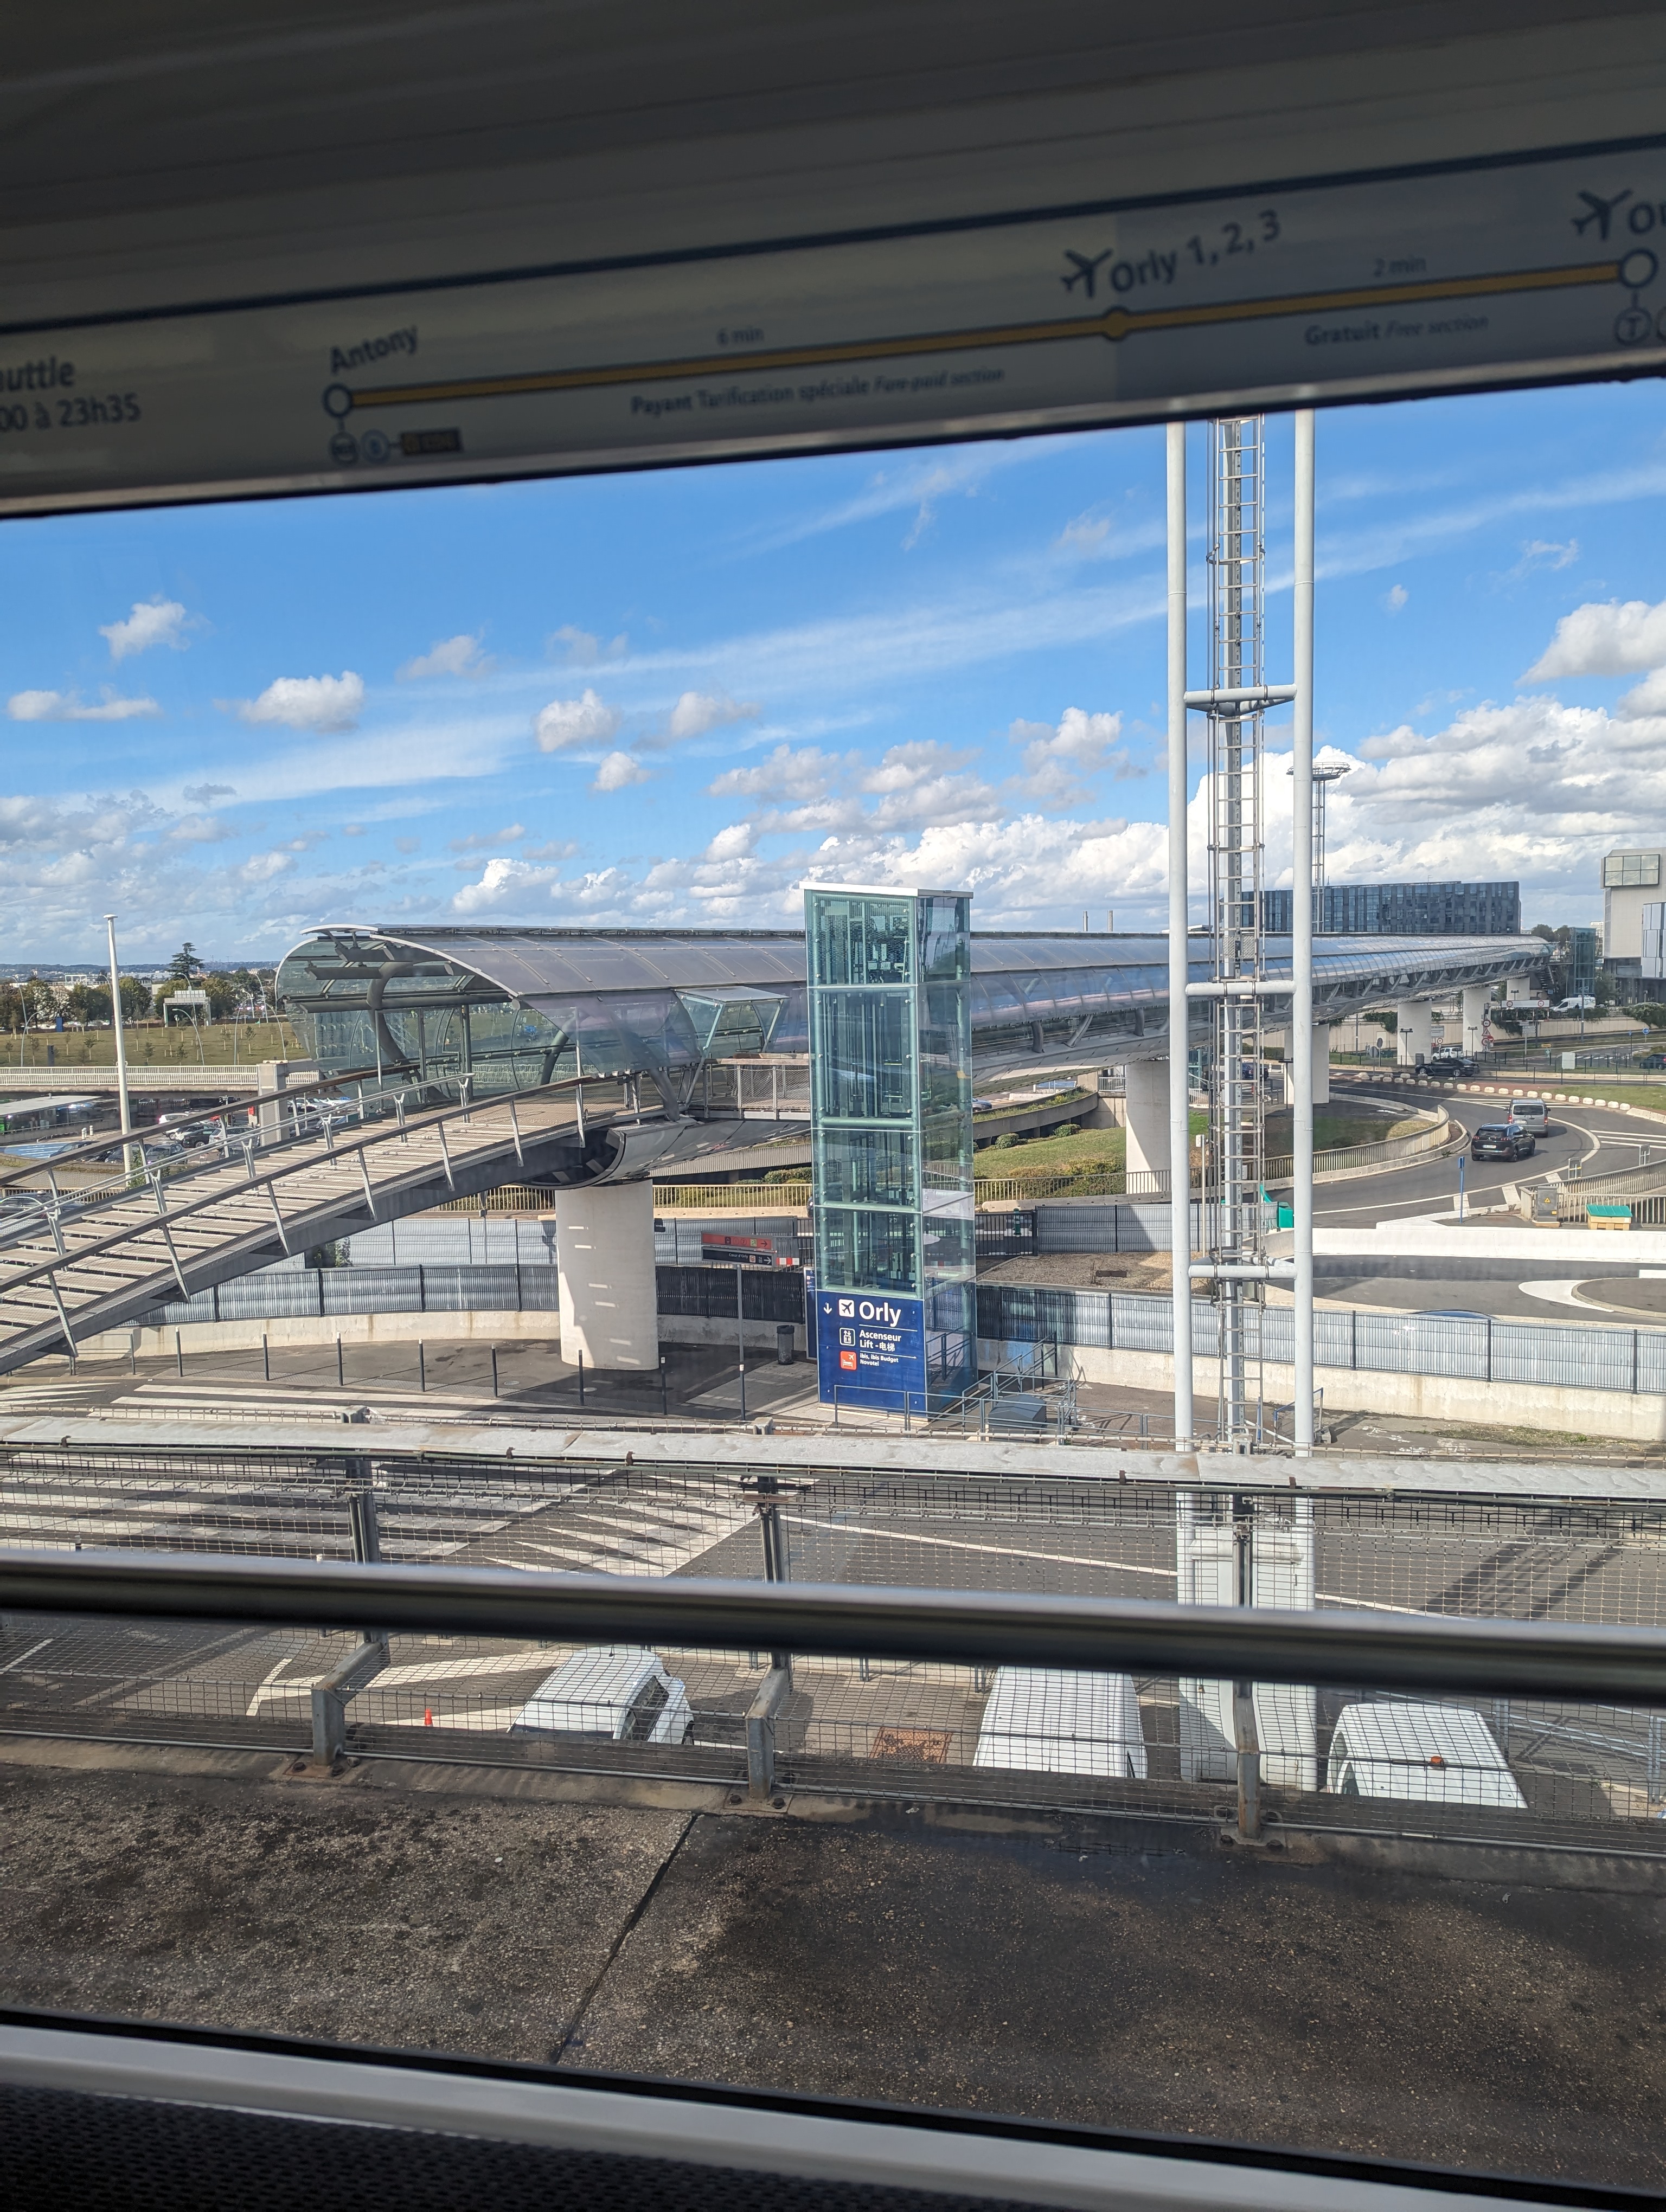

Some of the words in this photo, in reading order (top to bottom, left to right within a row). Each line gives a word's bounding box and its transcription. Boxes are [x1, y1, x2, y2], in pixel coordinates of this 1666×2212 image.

[1110, 248, 1178, 292] Orly
[1187, 235, 1219, 265] 1,
[1222, 221, 1254, 254] 2,
[1259, 209, 1280, 242] 3
[1374, 257, 1386, 278] 2
[1389, 254, 1427, 273] min
[716, 328, 729, 346] 6
[733, 325, 764, 343] min
[1304, 319, 1380, 346] Gratuit
[1427, 313, 1489, 334] section
[330, 325, 418, 375] Antony
[630, 395, 692, 417] Payant
[697, 385, 795, 408] Tarification
[798, 375, 870, 401] spéciale
[950, 368, 1005, 385] section
[34, 401, 52, 429] à
[56, 393, 142, 427] 23h35
[859, 1301, 901, 1327] Orly
[859, 1329, 901, 1342] Ascenseur
[860, 1339, 874, 1349] Lift
[879, 1341, 895, 1352] 电梯
